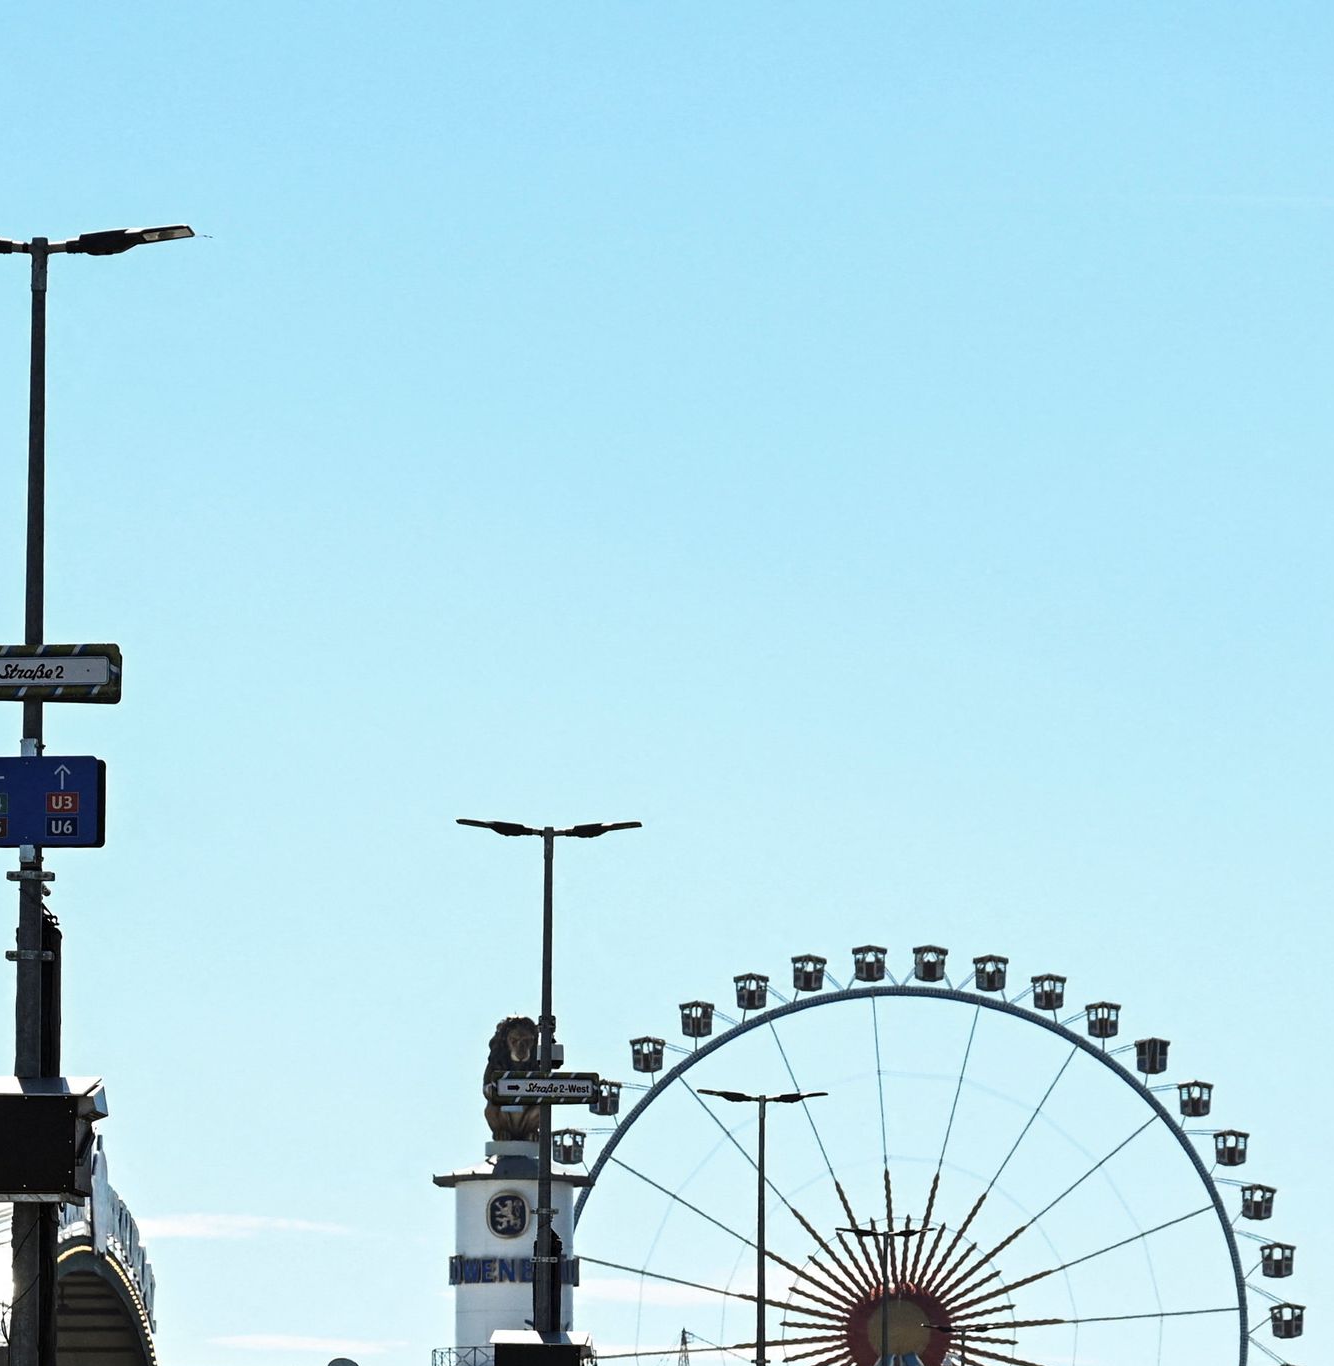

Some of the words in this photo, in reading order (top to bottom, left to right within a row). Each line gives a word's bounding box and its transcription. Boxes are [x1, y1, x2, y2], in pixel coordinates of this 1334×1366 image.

[55, 665, 64, 679] 2
[51, 795, 72, 809] U3
[51, 820, 73, 834] U6
[525, 1083, 559, 1096] Straße
[559, 1084, 590, 1094] 2-West
